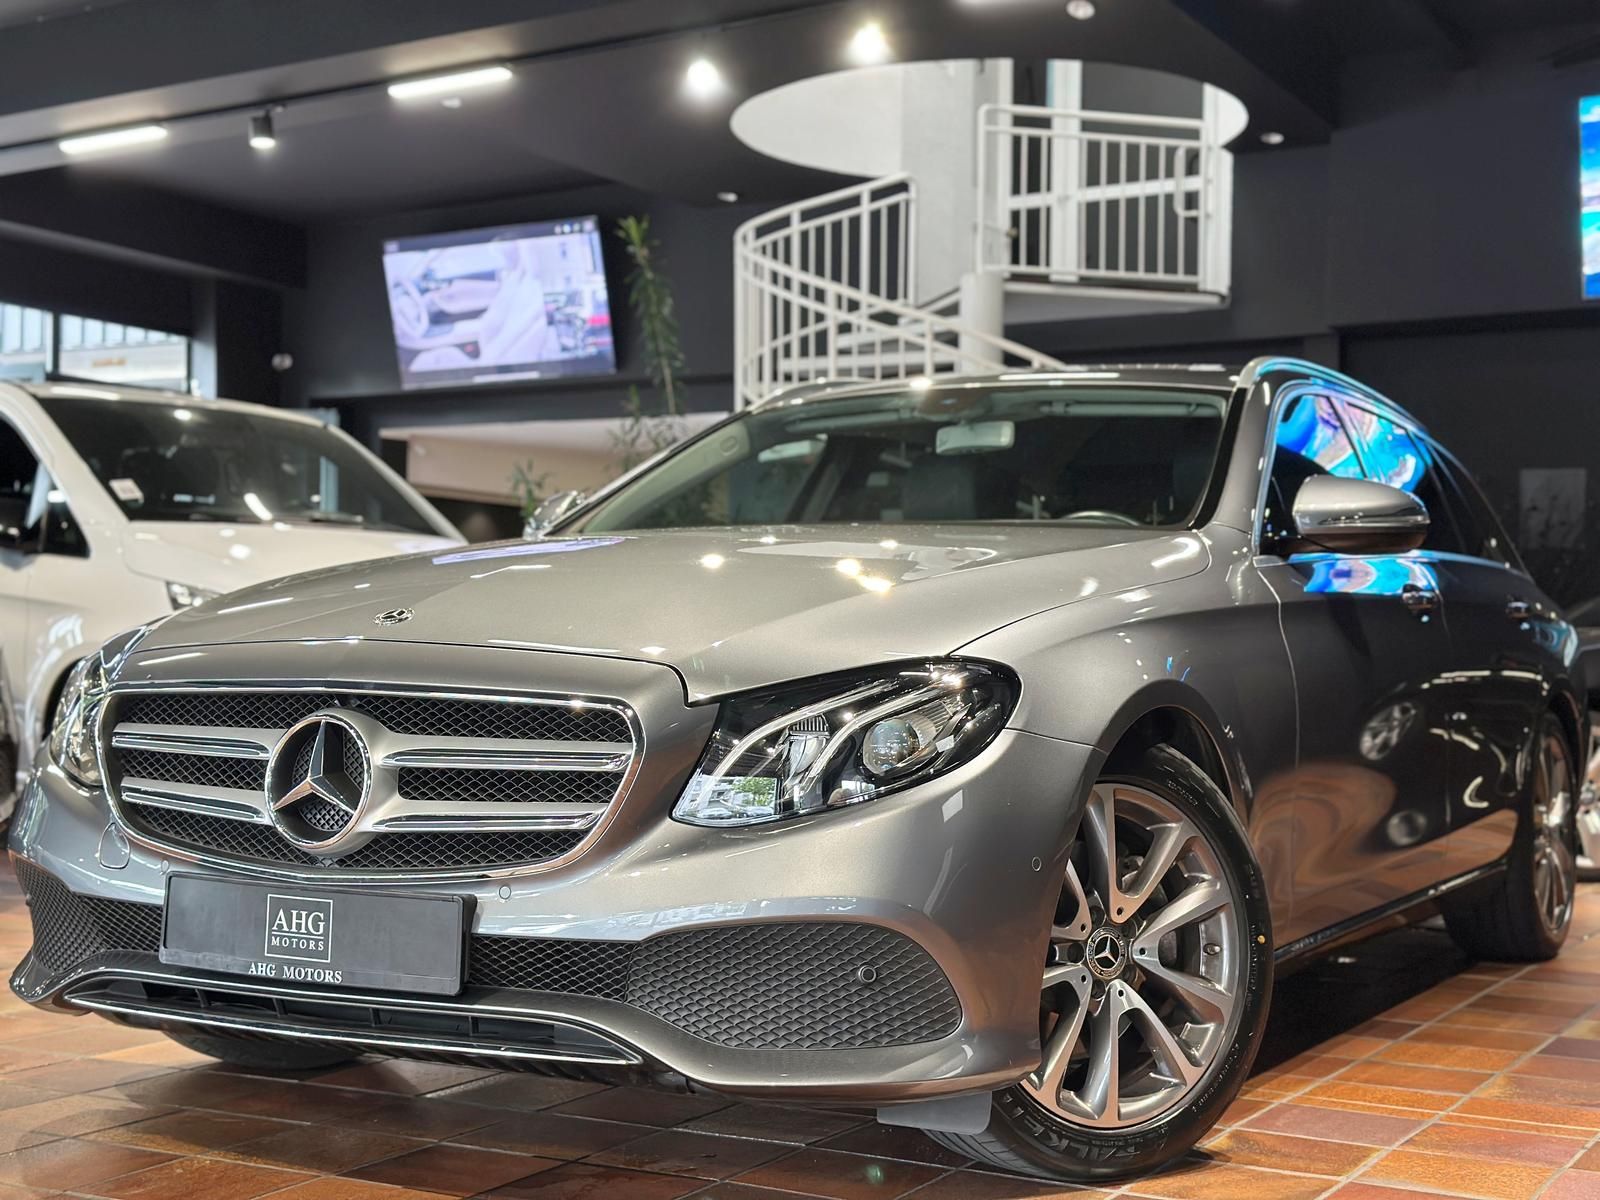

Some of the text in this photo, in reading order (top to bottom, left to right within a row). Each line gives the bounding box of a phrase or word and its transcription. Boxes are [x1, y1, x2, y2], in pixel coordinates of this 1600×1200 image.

[272, 908, 325, 935] AHG
[271, 936, 325, 951] MOTORS
[248, 962, 342, 983] AHG MOTORS
